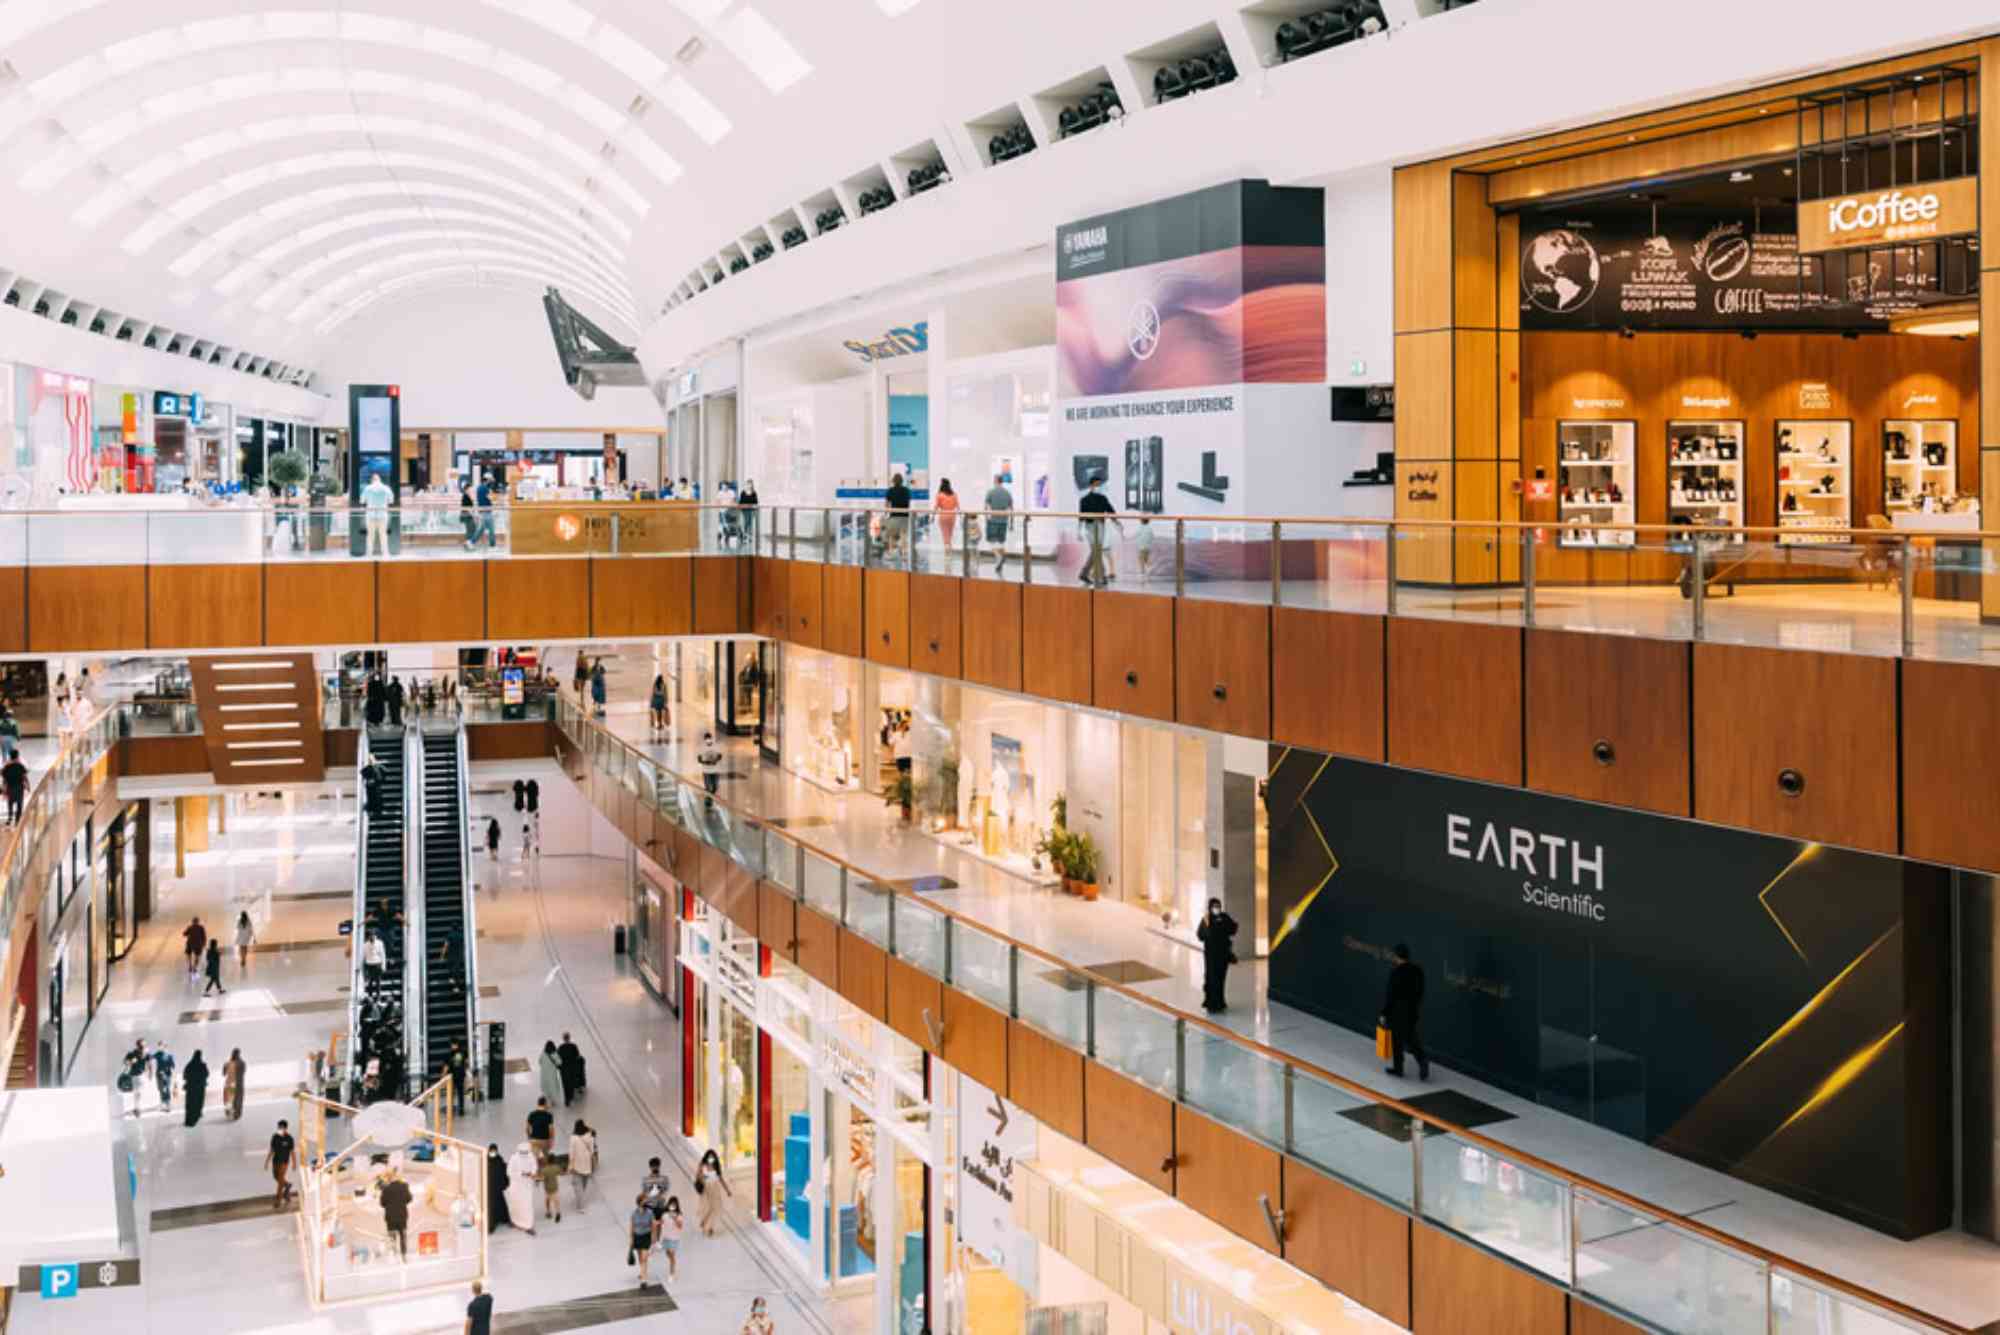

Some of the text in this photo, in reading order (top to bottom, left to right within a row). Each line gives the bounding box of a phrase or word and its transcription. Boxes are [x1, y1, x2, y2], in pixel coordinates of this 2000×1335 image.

[1828, 193, 1939, 232] iCoffee
[1073, 227, 1107, 251] YAMAHA
[1714, 288, 1763, 314] COFFEE
[1076, 407, 1088, 420] ARE
[1090, 404, 1120, 419] WORKING
[1131, 401, 1164, 417] ENHANCE
[1166, 399, 1185, 414] YOUR
[1187, 396, 1233, 413] EXPERIENCE
[1447, 814, 1604, 891] EARTH
[1522, 881, 1606, 921] Scientific
[51, 1269, 71, 1295] P
